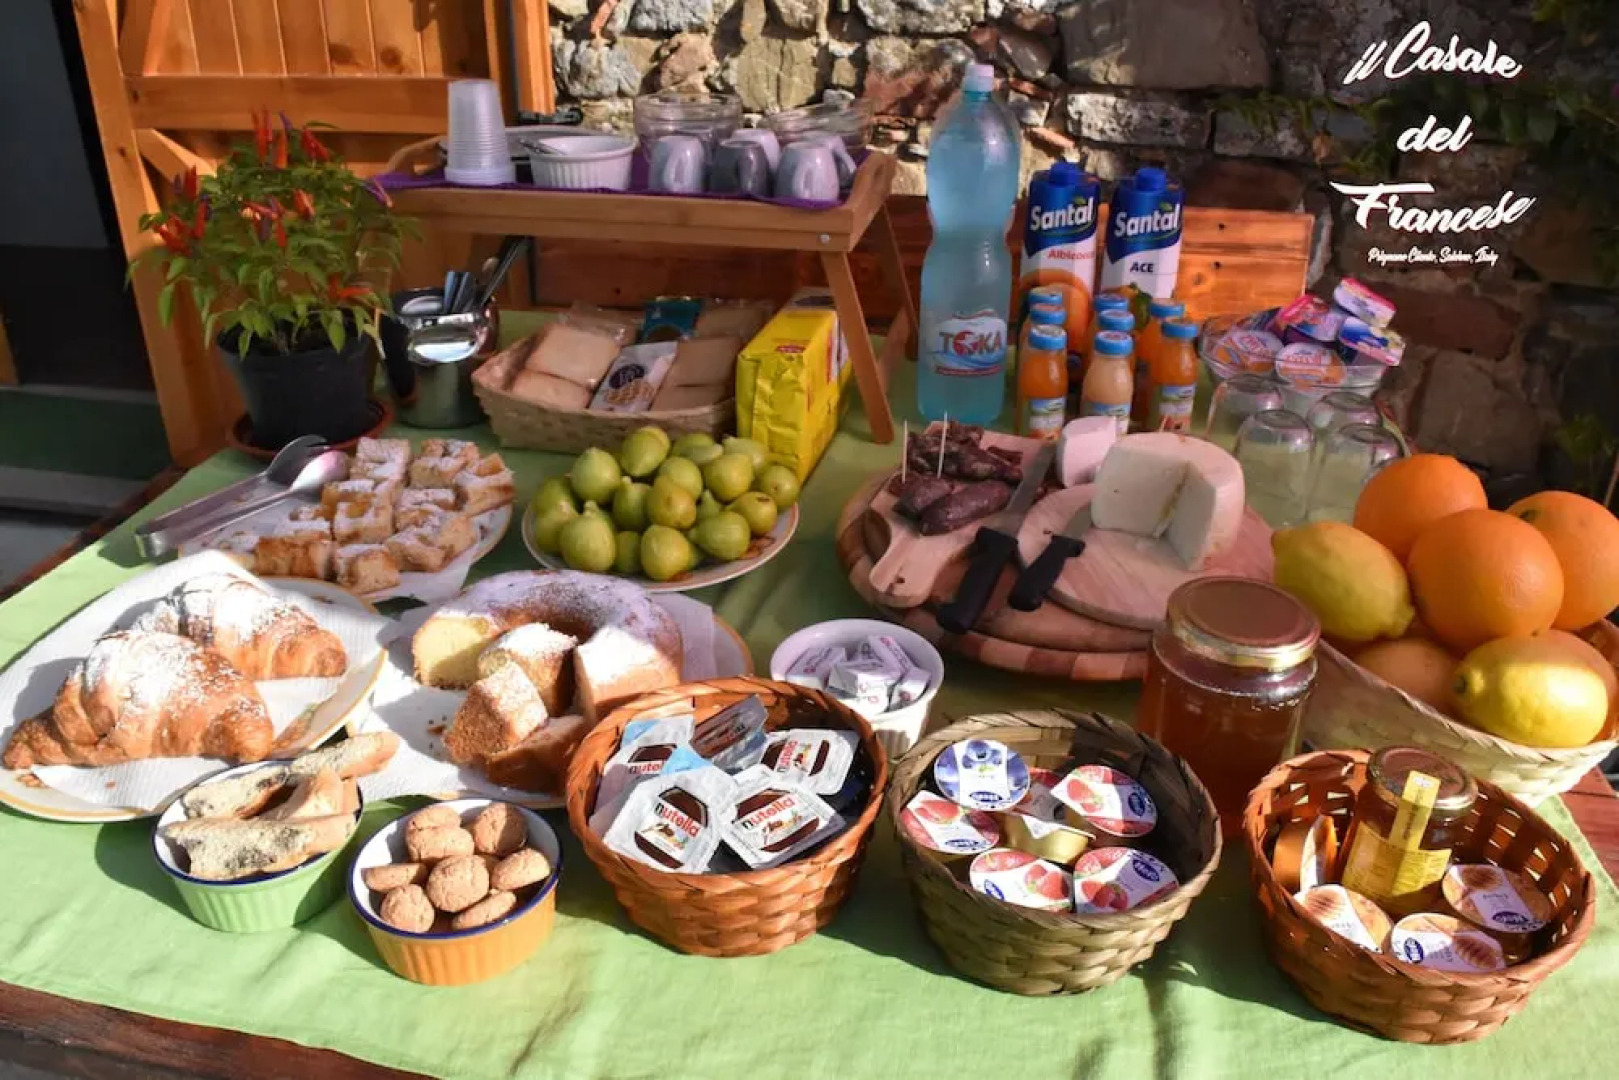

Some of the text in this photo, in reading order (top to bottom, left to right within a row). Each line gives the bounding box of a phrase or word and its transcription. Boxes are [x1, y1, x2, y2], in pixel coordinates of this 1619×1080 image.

[1030, 196, 1094, 231] Santal
[1113, 203, 1181, 238] Santal
[1130, 261, 1155, 273] ACE
[654, 802, 701, 838] nutella
[741, 797, 796, 830] nutella
